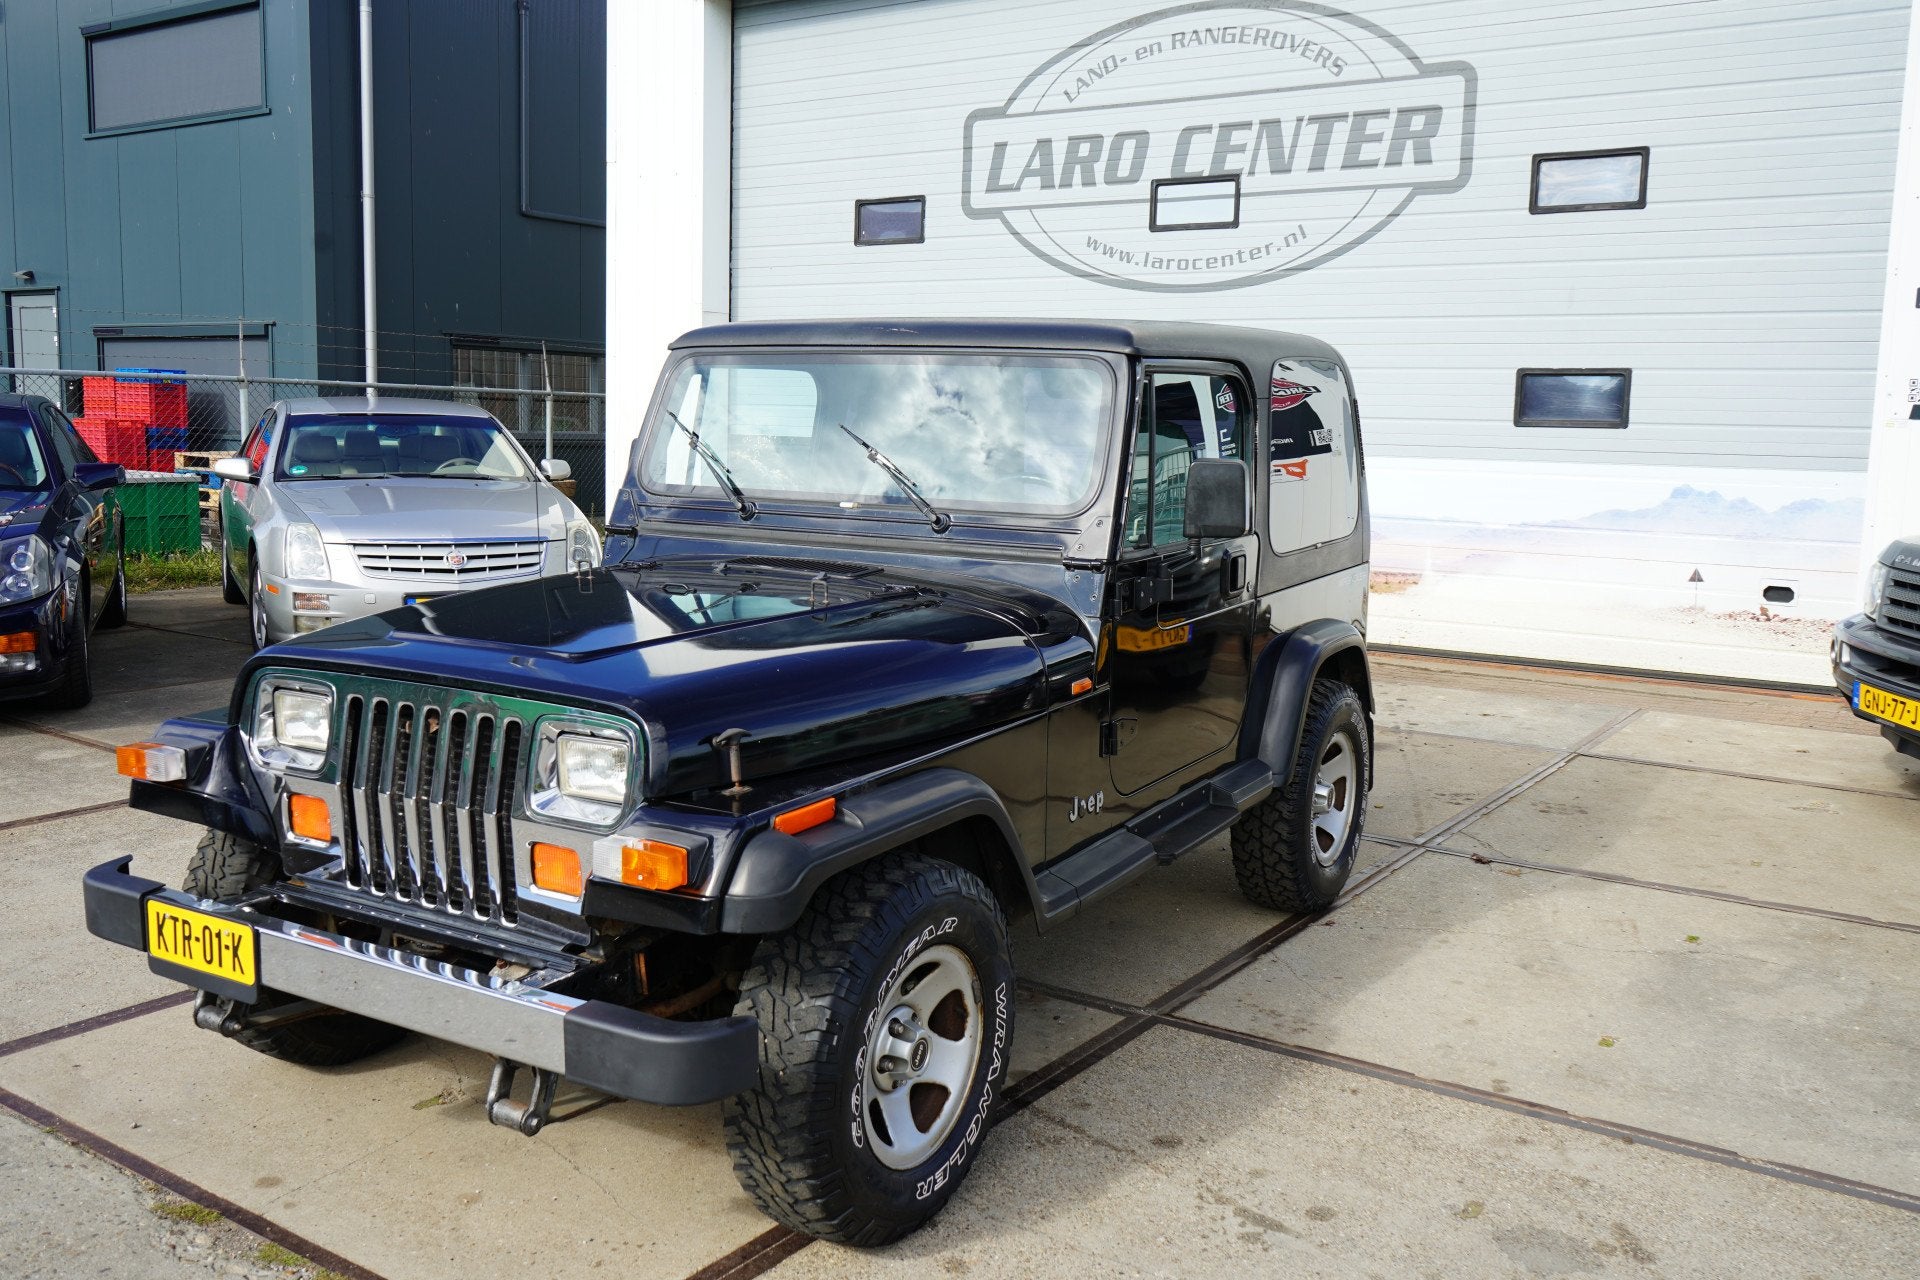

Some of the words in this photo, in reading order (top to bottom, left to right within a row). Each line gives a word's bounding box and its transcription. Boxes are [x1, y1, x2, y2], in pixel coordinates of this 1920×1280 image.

[1062, 54, 1128, 104] LAND-
[1134, 41, 1163, 61] en
[1171, 26, 1348, 78] RANGEROVERS
[984, 129, 1150, 195] LARO
[1169, 104, 1443, 179] CENTER
[1085, 224, 1308, 271] www.larocenter.nl
[156, 911, 245, 975] KTR-01-K
[852, 916, 958, 1149] GOODYEAR
[915, 981, 1007, 1200] WRANGLER
